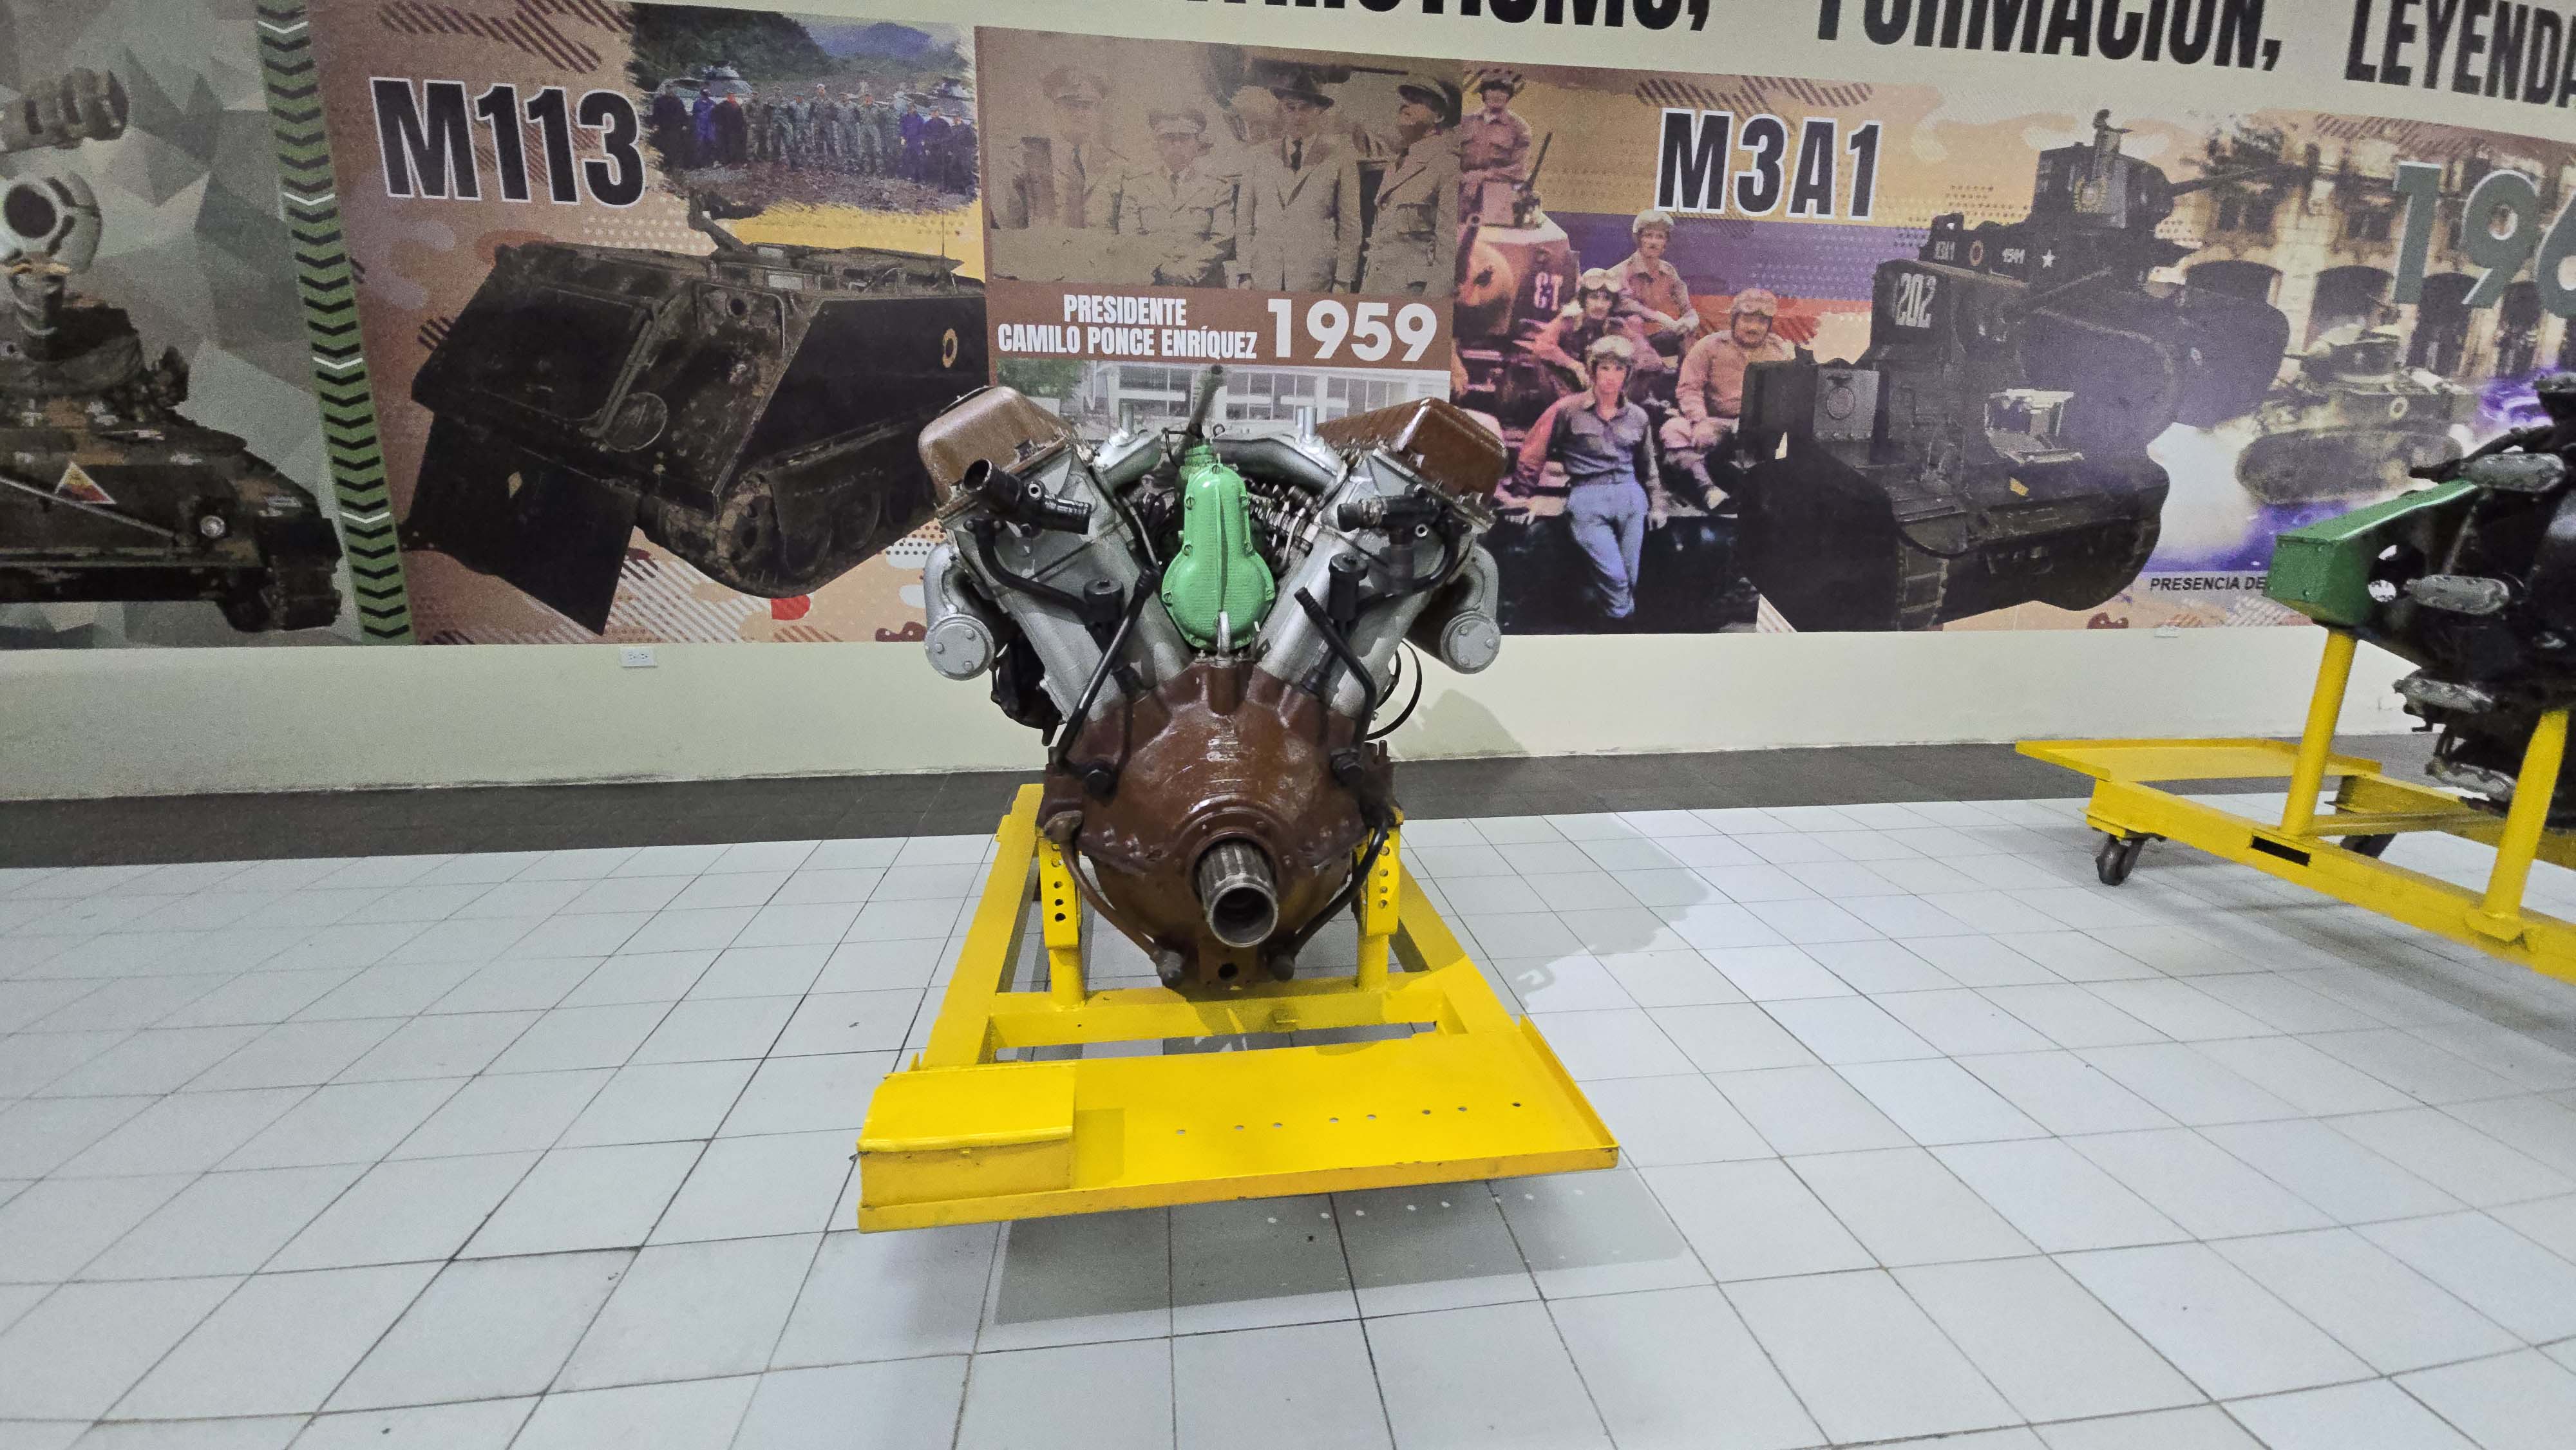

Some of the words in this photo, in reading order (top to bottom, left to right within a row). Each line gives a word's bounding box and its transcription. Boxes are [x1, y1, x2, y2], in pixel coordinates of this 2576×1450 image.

[370, 77, 645, 207] M113
[1653, 107, 1882, 221] M3A1
[1064, 294, 1187, 326] PRESIDENTE
[1895, 273, 1937, 328] 202
[998, 324, 1081, 353] CAMILO
[1087, 326, 1155, 356] PONCE
[1161, 326, 1258, 360] ENRÍQUEZ
[1267, 298, 1437, 362] 1959
[2150, 576, 2240, 591] PRESENCIA
